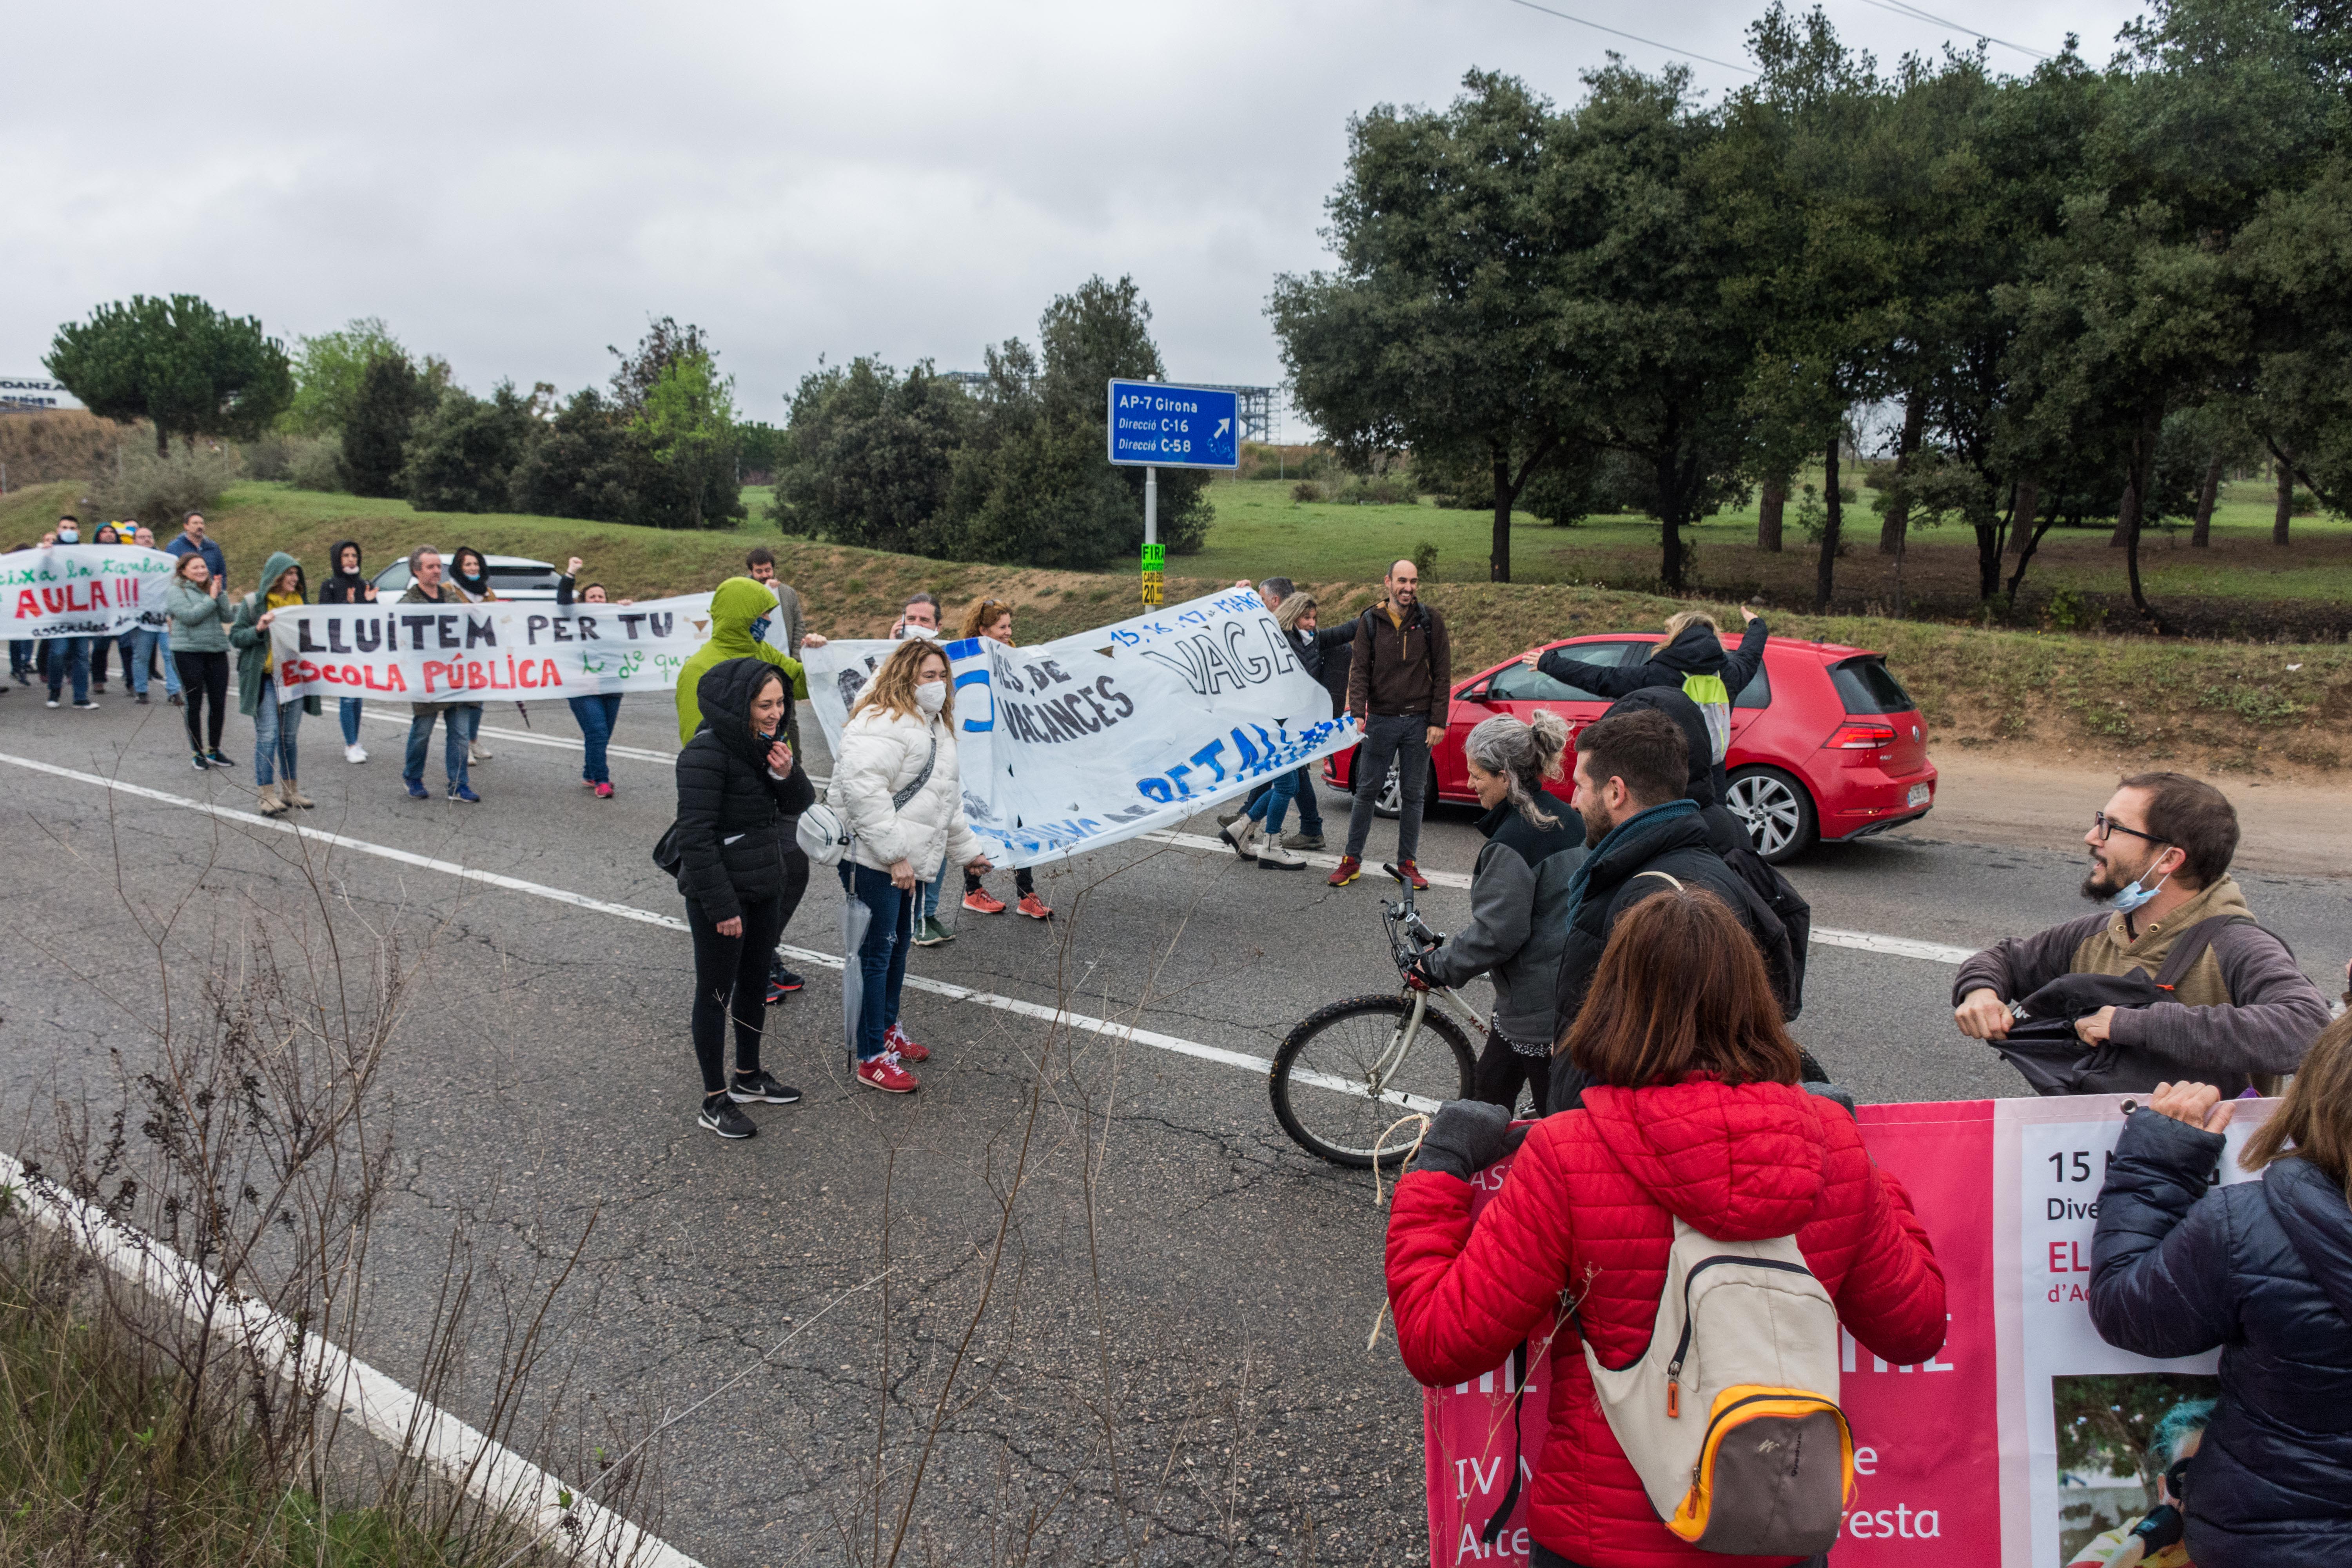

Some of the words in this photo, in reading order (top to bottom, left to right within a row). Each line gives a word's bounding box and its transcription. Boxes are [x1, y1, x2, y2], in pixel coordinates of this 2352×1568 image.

[1120, 395, 1152, 409] AP-7
[1156, 397, 1198, 413] Girona
[1119, 418, 1156, 430] Direcció
[1161, 418, 1189, 432] C-16
[1119, 438, 1156, 451] Direcció
[1161, 439, 1191, 452] C-58
[1144, 584, 1154, 603] 20
[527, 615, 601, 645] PER
[618, 612, 673, 640] TU
[281, 660, 407, 692] ESCOLA
[1022, 660, 1072, 691] DE
[997, 675, 1134, 744] VACANCES
[2048, 1151, 2091, 1183] 15
[1455, 1456, 1501, 1500] IV
